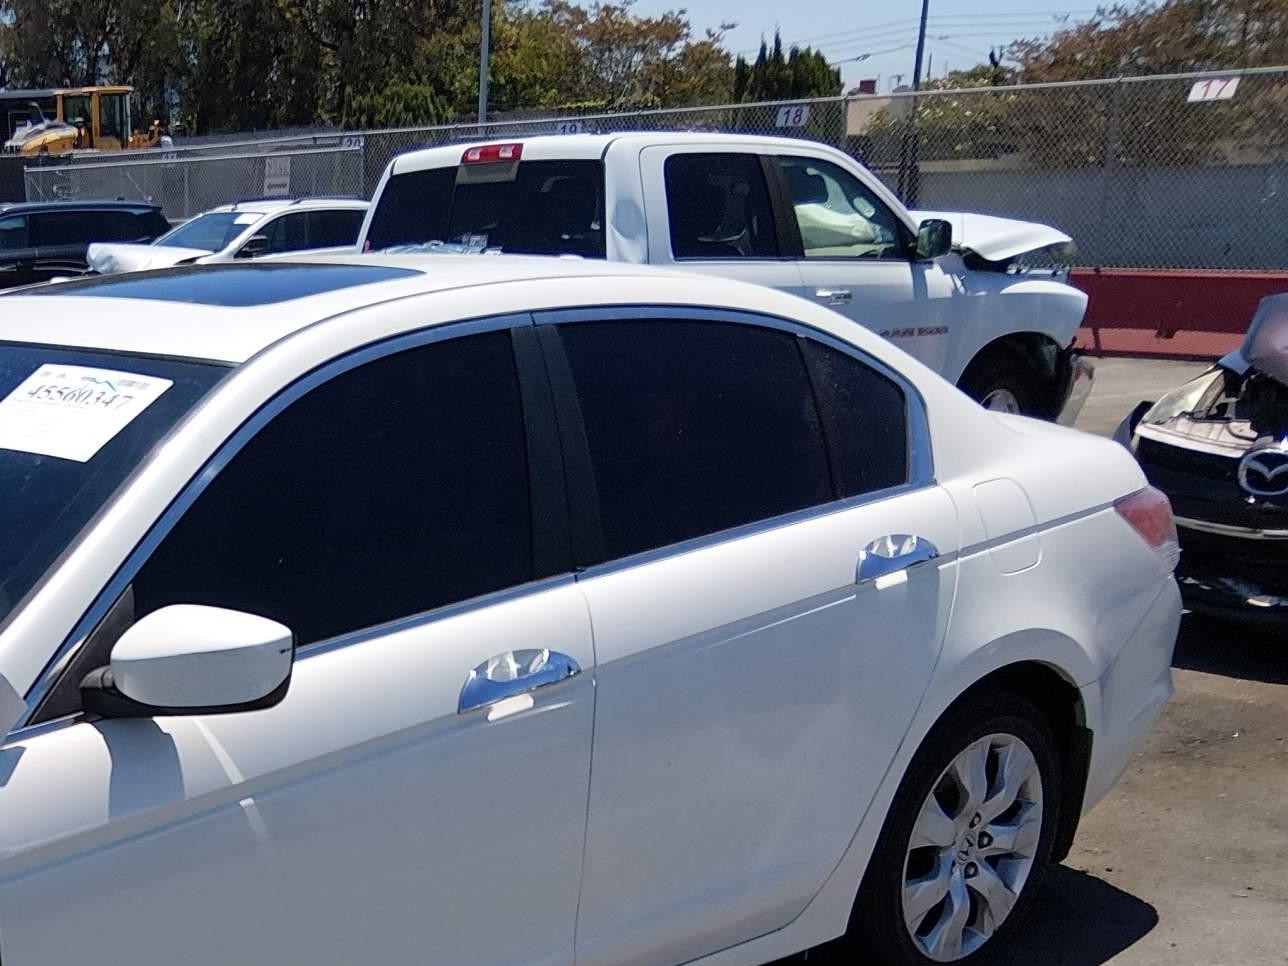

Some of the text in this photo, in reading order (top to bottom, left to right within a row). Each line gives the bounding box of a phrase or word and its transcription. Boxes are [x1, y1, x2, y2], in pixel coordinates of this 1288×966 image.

[1200, 79, 1232, 99] 17
[782, 108, 802, 126] 18
[27, 384, 135, 410] 45560347
